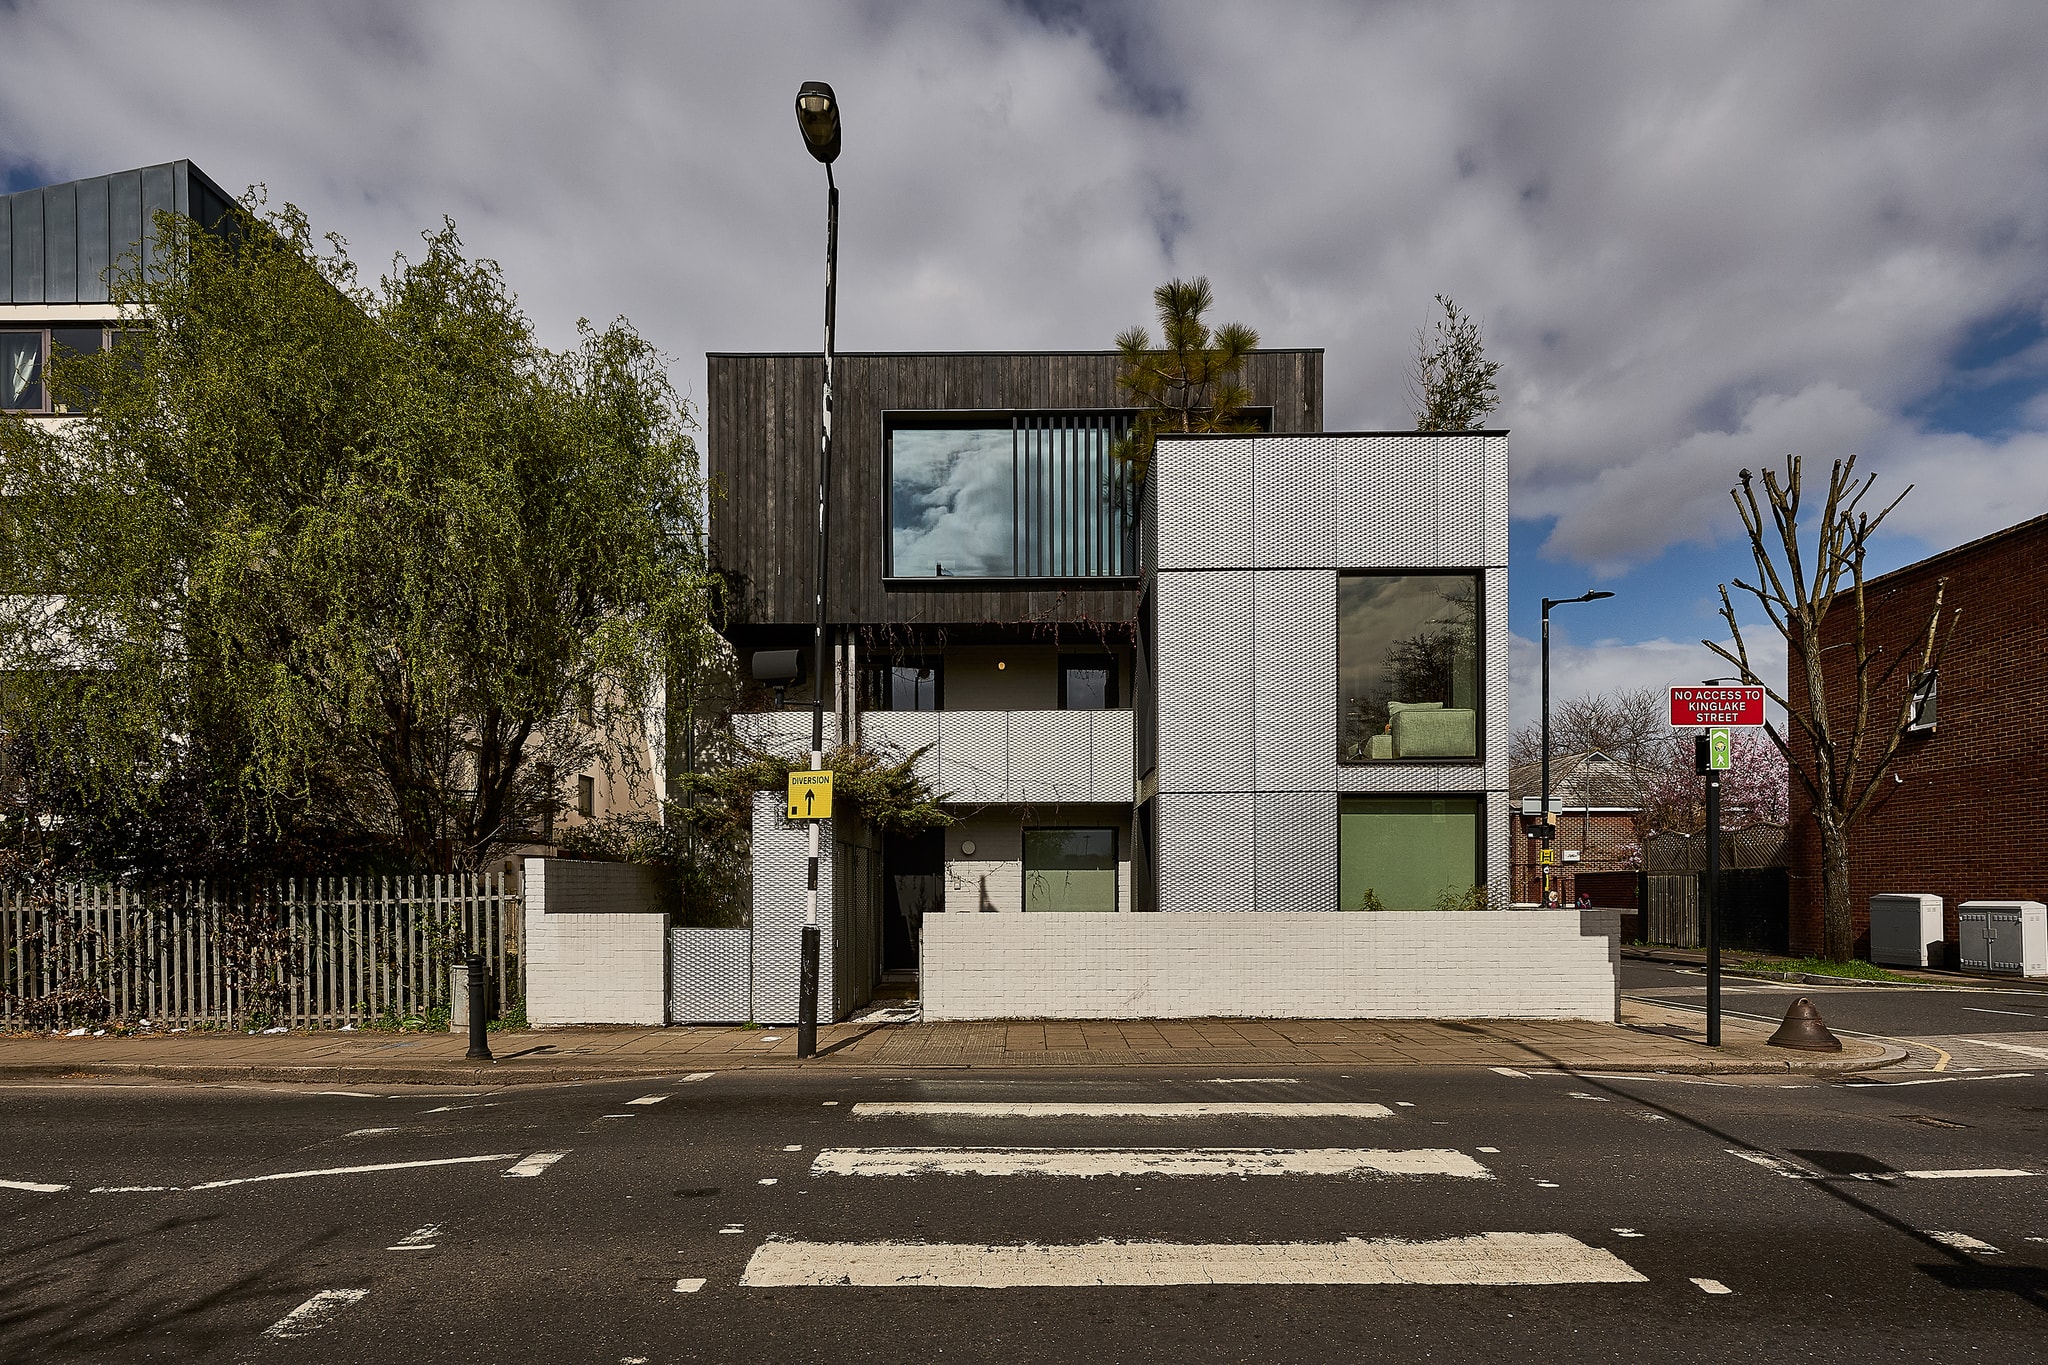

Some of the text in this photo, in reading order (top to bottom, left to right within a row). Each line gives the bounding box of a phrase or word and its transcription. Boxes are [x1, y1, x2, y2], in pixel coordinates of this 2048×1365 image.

[1674, 690, 1760, 701] NO ACCESS TO
[1688, 701, 1746, 711] KINGLAKE
[1696, 713, 1739, 722] STREET
[792, 776, 830, 785] DIVERSION
